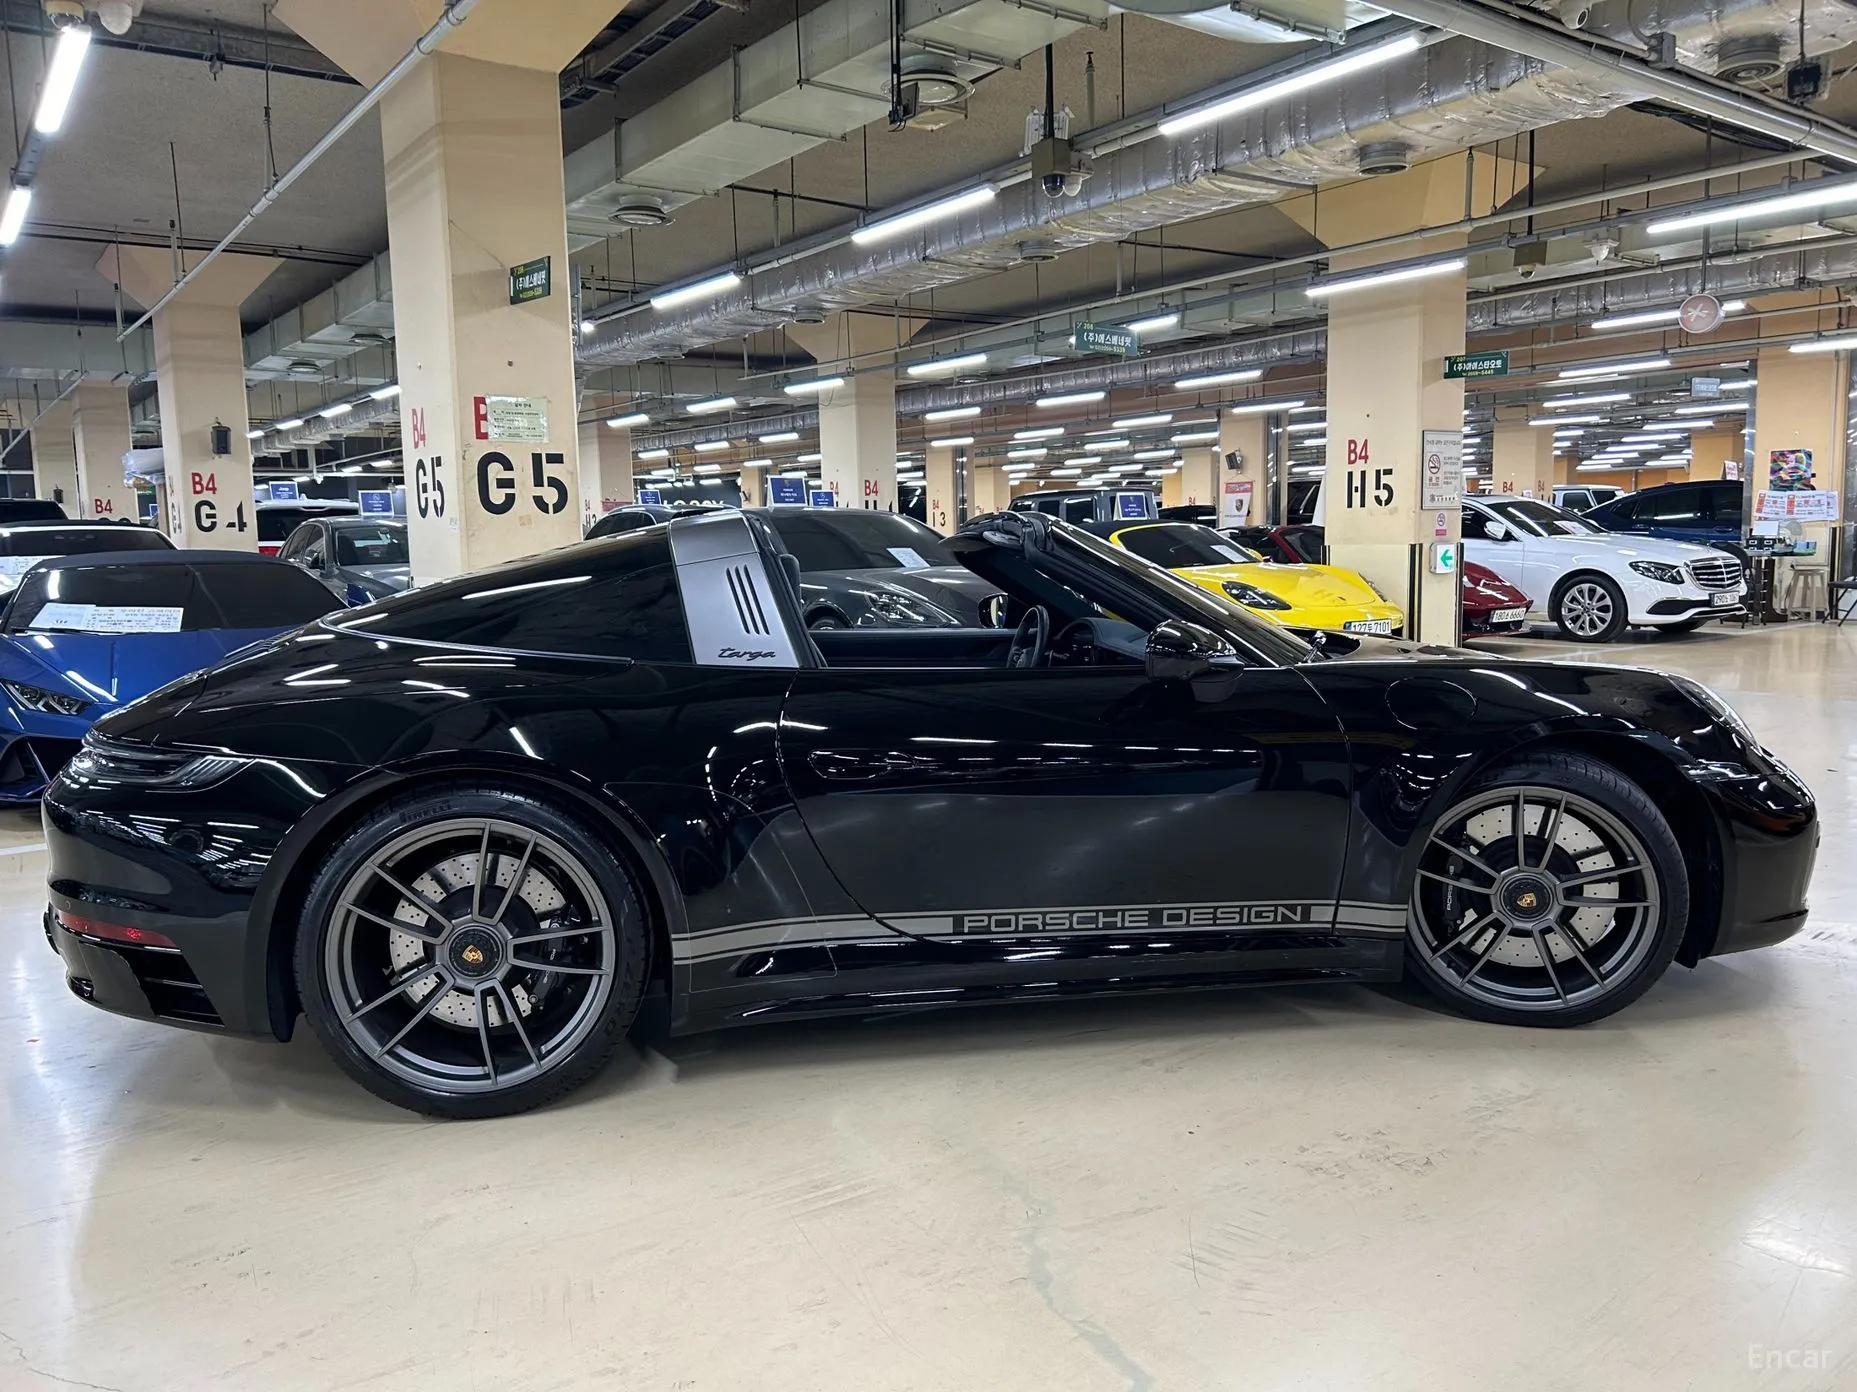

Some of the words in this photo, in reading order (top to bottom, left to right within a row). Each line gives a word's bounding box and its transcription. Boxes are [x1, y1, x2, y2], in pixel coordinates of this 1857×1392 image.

[411, 407, 426, 450] B4
[1347, 438, 1369, 465] B4
[191, 472, 217, 495] B4
[415, 455, 445, 519] G5
[865, 480, 879, 497] B4
[1346, 468, 1394, 509] H5
[1503, 481, 1513, 493] B4
[94, 498, 113, 514] B4
[717, 646, 777, 662] targa
[963, 910, 1149, 934] PORSCHE
[1162, 905, 1302, 927] DESIGN
